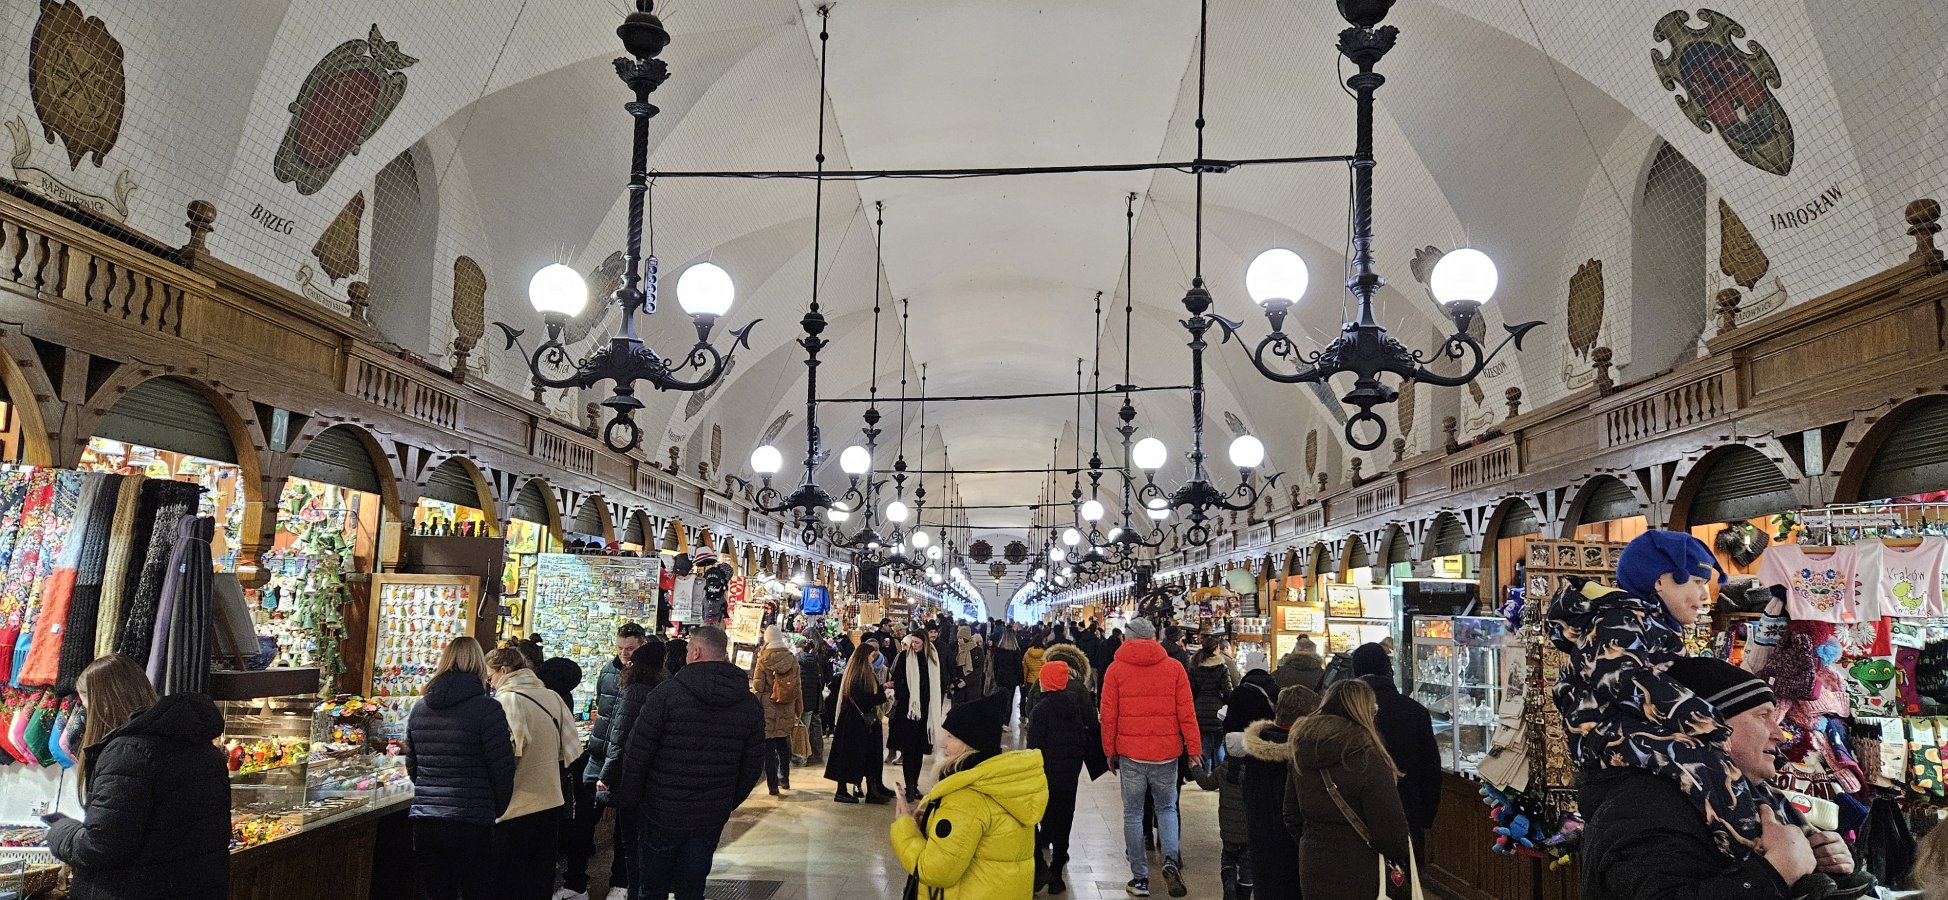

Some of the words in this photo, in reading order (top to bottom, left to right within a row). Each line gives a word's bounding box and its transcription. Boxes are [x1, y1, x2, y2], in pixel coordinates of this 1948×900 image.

[250, 204, 295, 235] BRZEG
[1769, 182, 1844, 231] JAROSŁAW
[272, 415, 288, 444] 21
